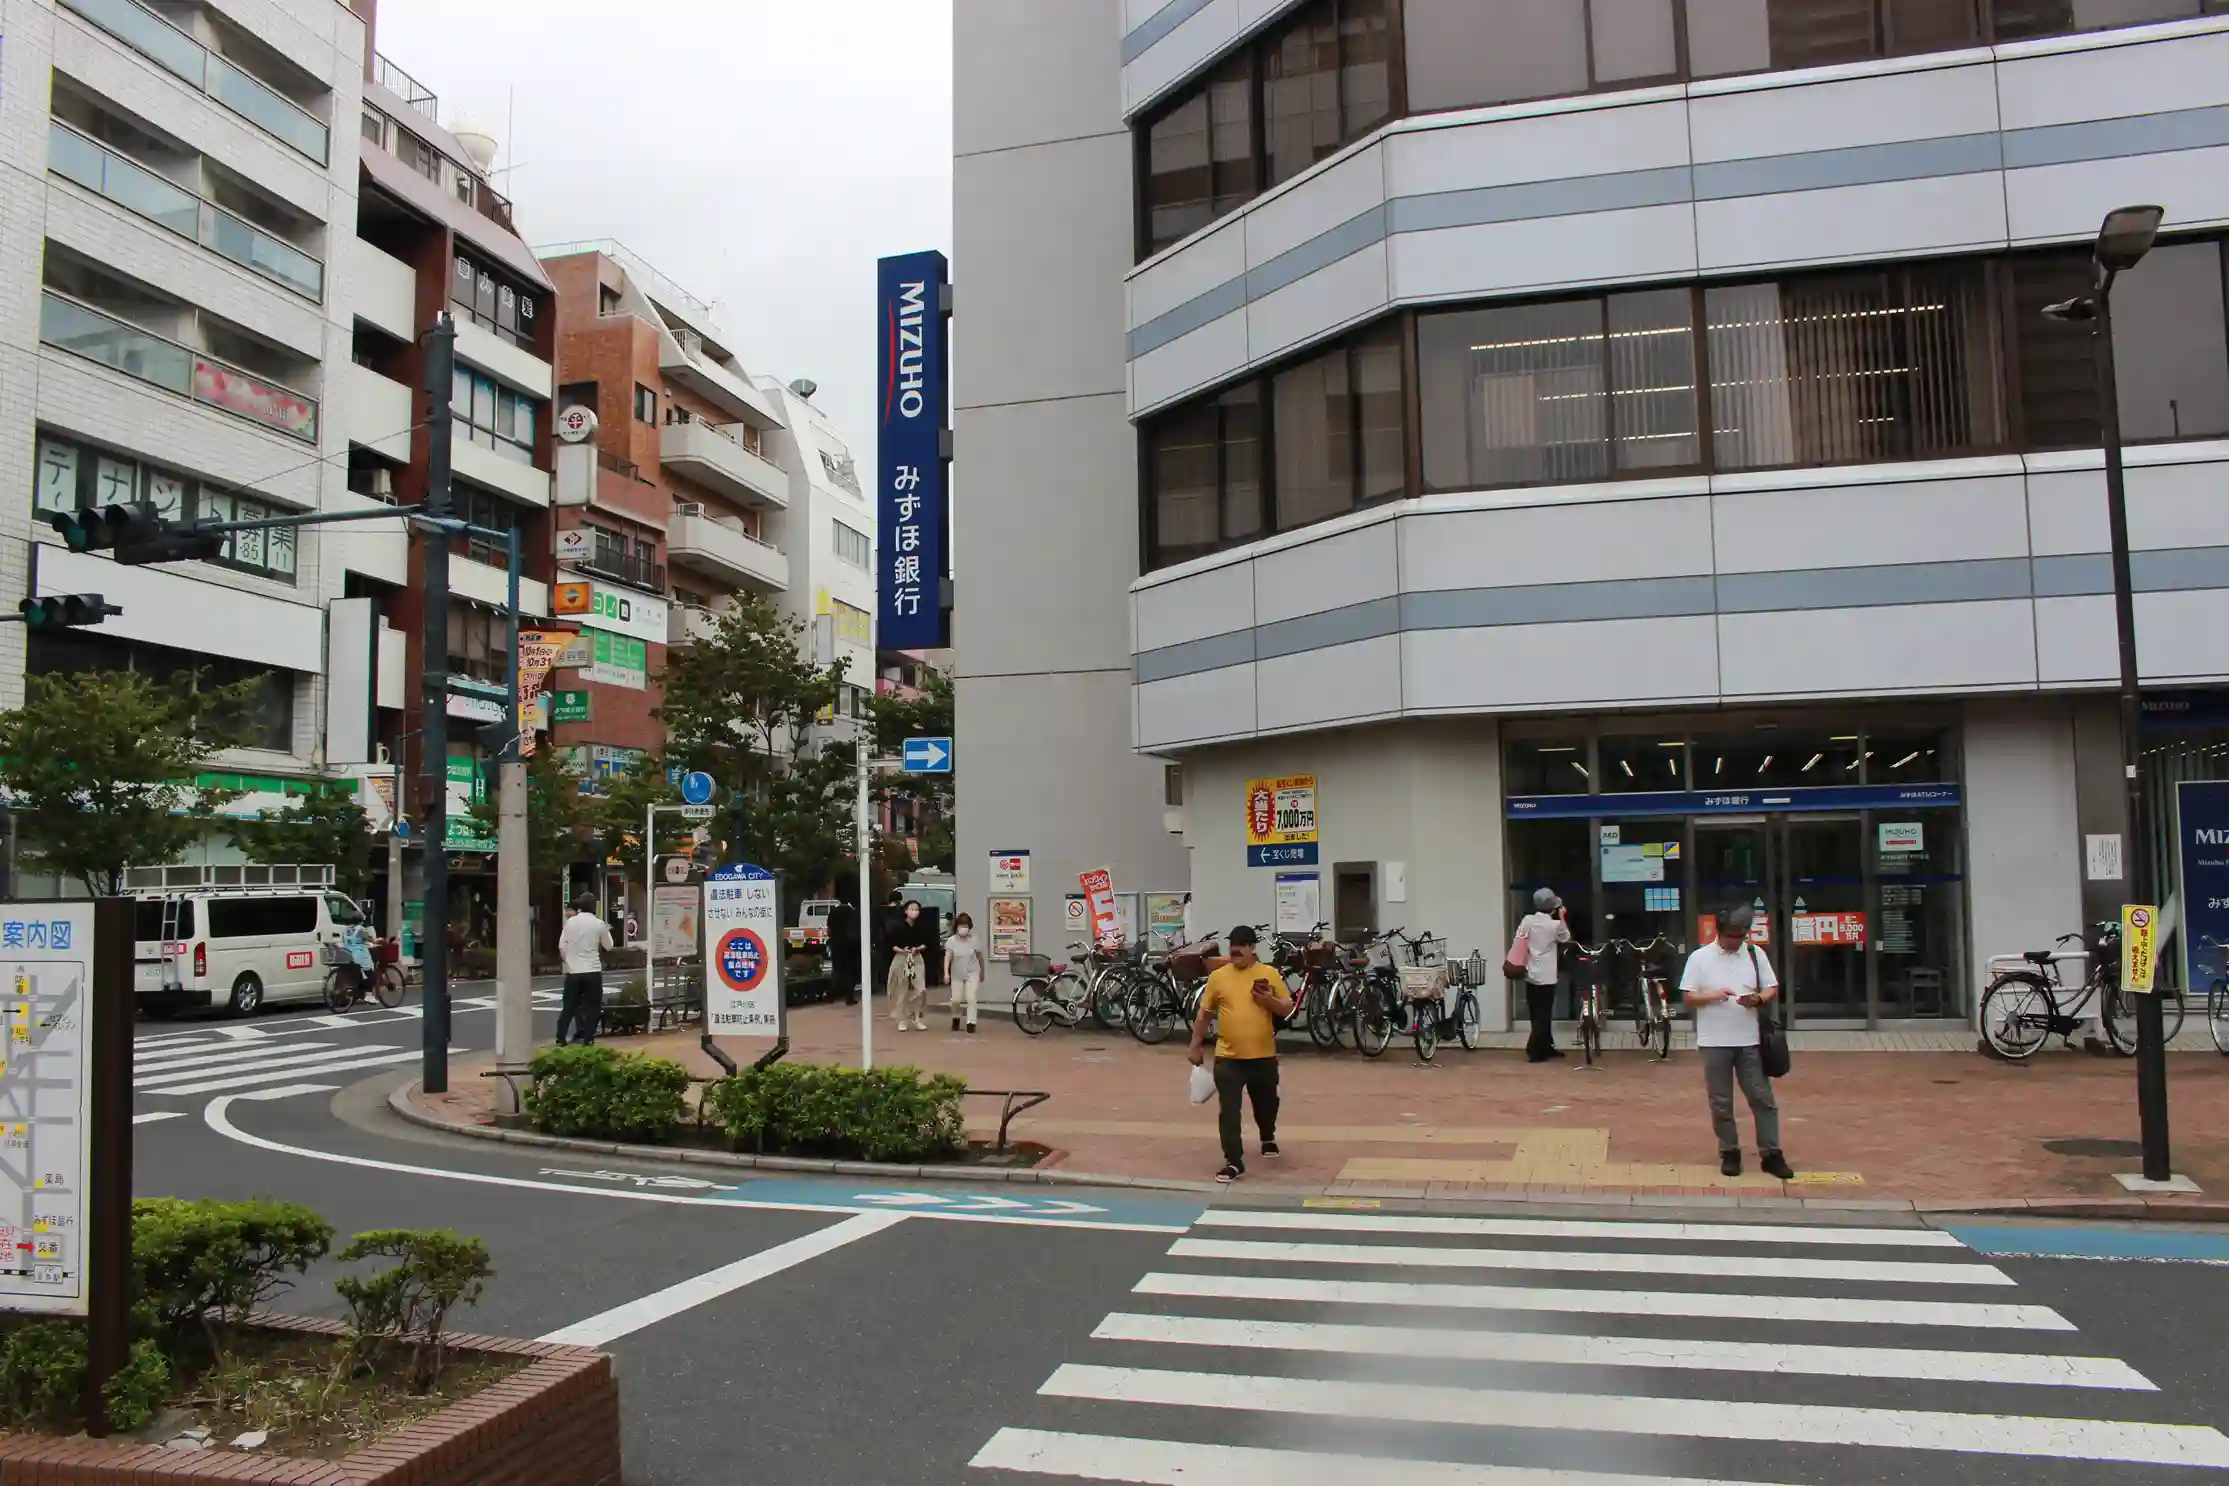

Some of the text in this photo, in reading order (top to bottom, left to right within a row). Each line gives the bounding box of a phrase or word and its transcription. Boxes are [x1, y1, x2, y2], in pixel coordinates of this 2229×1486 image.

[899, 280, 924, 418] MIZUHO
[894, 465, 921, 616] みずほ銀行
[1254, 790, 1269, 833] 大当たり
[1705, 796, 1750, 806] みずほ銀行
[1276, 809, 1315, 832] 7,000万円
[714, 872, 764, 881] EDOGAWA CITY
[746, 887, 770, 900] しない
[3, 919, 72, 950] 案内図
[1791, 915, 1840, 943] 億円
[729, 942, 752, 950] ここは
[734, 970, 750, 978] です
